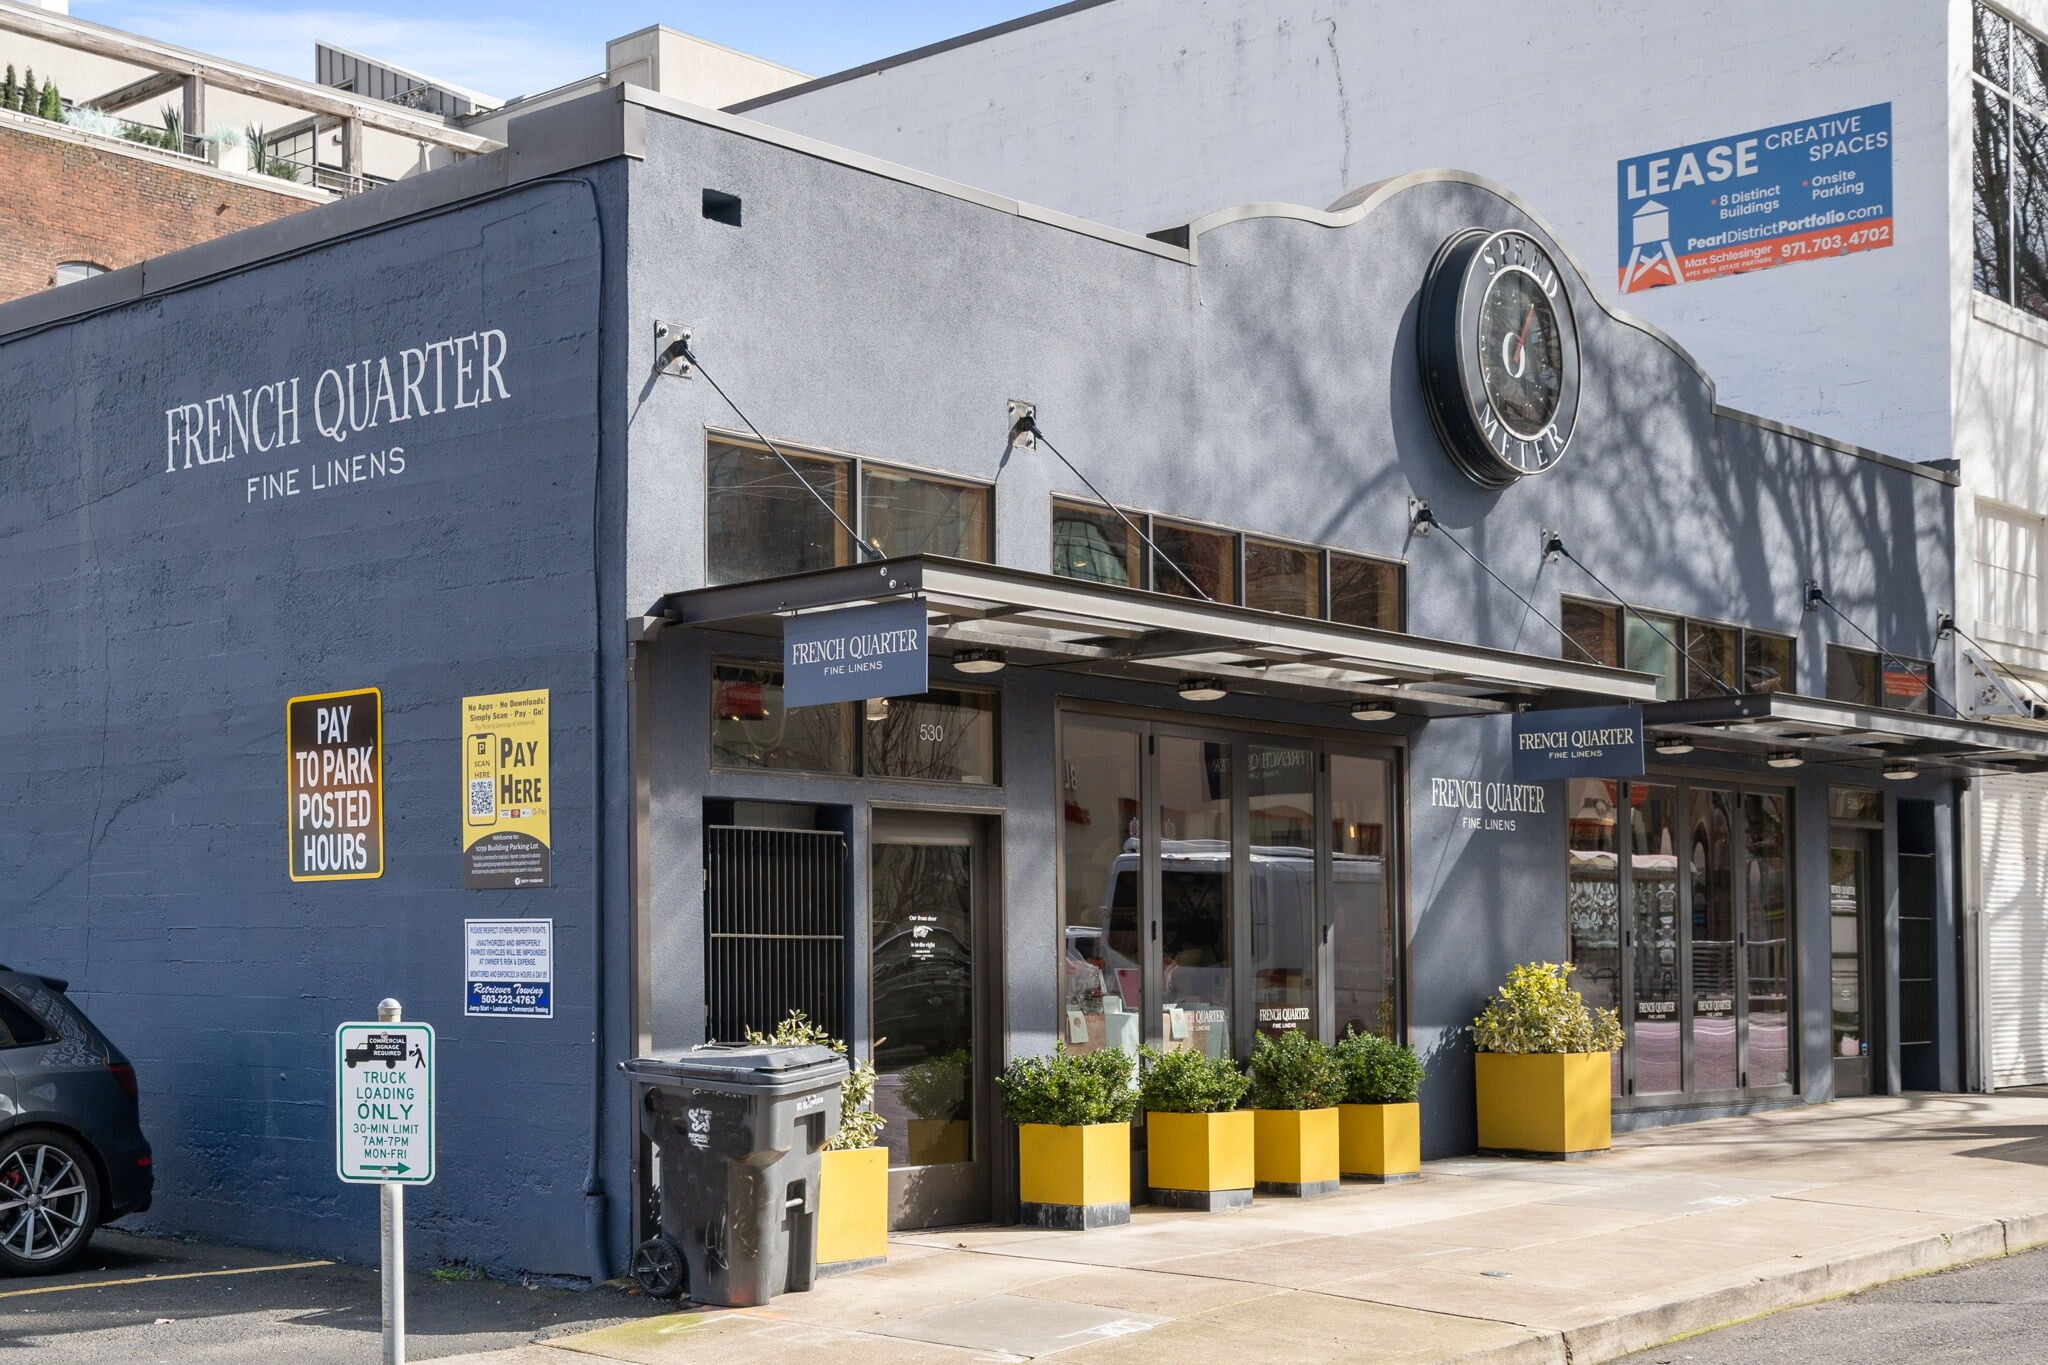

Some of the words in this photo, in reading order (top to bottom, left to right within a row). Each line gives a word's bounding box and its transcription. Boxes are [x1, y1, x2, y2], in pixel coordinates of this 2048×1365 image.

[1765, 116, 1862, 150] CREATIVE
[1809, 131, 1888, 162] SPACES
[1627, 139, 1759, 200] LEASE
[1812, 170, 1856, 187] Onsite
[1720, 195, 1728, 206] 8
[1732, 185, 1781, 205] Distinct
[1812, 180, 1864, 200] Parking
[1720, 199, 1780, 220] Buildings
[1687, 204, 1884, 251] PearlDistrictPortfolio.com
[1781, 225, 1890, 258] 971.703.4702
[1685, 258, 1707, 268] Max
[1710, 246, 1772, 264] Schlesinger
[165, 377, 301, 473] FRENCH
[314, 328, 511, 442] QUARTER
[247, 468, 300, 503] FINE
[312, 446, 405, 490] LINENS
[792, 638, 845, 665] FRENCH
[849, 628, 918, 659] QUARTER
[824, 665, 844, 676] FINE
[848, 660, 883, 673] LINENS
[478, 703, 493, 711] Apps
[510, 697, 546, 707] Downloads!
[317, 705, 352, 745] PAY
[470, 713, 491, 722] Simply
[514, 710, 526, 718] Pay
[533, 708, 544, 716] Go!
[919, 724, 943, 742] 530
[1519, 732, 1567, 750] FRENCH
[1571, 728, 1634, 748] QUARTER
[500, 737, 538, 768] PAY
[1549, 751, 1568, 759] FINE
[1571, 750, 1603, 758] LINENS
[296, 750, 319, 788] TO
[323, 745, 374, 786] PARK
[500, 774, 542, 804] HERE
[1431, 777, 1482, 809] FRENCH
[1486, 782, 1545, 814] QUARTER
[299, 789, 371, 830] POSTED
[1462, 817, 1481, 829] FINE
[1485, 819, 1516, 832] LINENS
[303, 832, 367, 871] HOURS
[473, 982, 512, 994] Retriever
[514, 983, 544, 998] Towing
[481, 994, 536, 1004] 503-222-4763
[1196, 1010, 1224, 1023] QUARTER
[1260, 1008, 1281, 1021] FRENCH
[1282, 1008, 1310, 1020] QUARTER
[364, 1071, 407, 1084] TRUCK
[356, 1087, 414, 1100] LOADING
[358, 1103, 414, 1120] ONLY
[353, 1124, 389, 1134] 30-MIN
[392, 1124, 420, 1134] LIMIT
[362, 1136, 409, 1146] 7AM-7PM
[364, 1148, 407, 1159] MON-FRI
